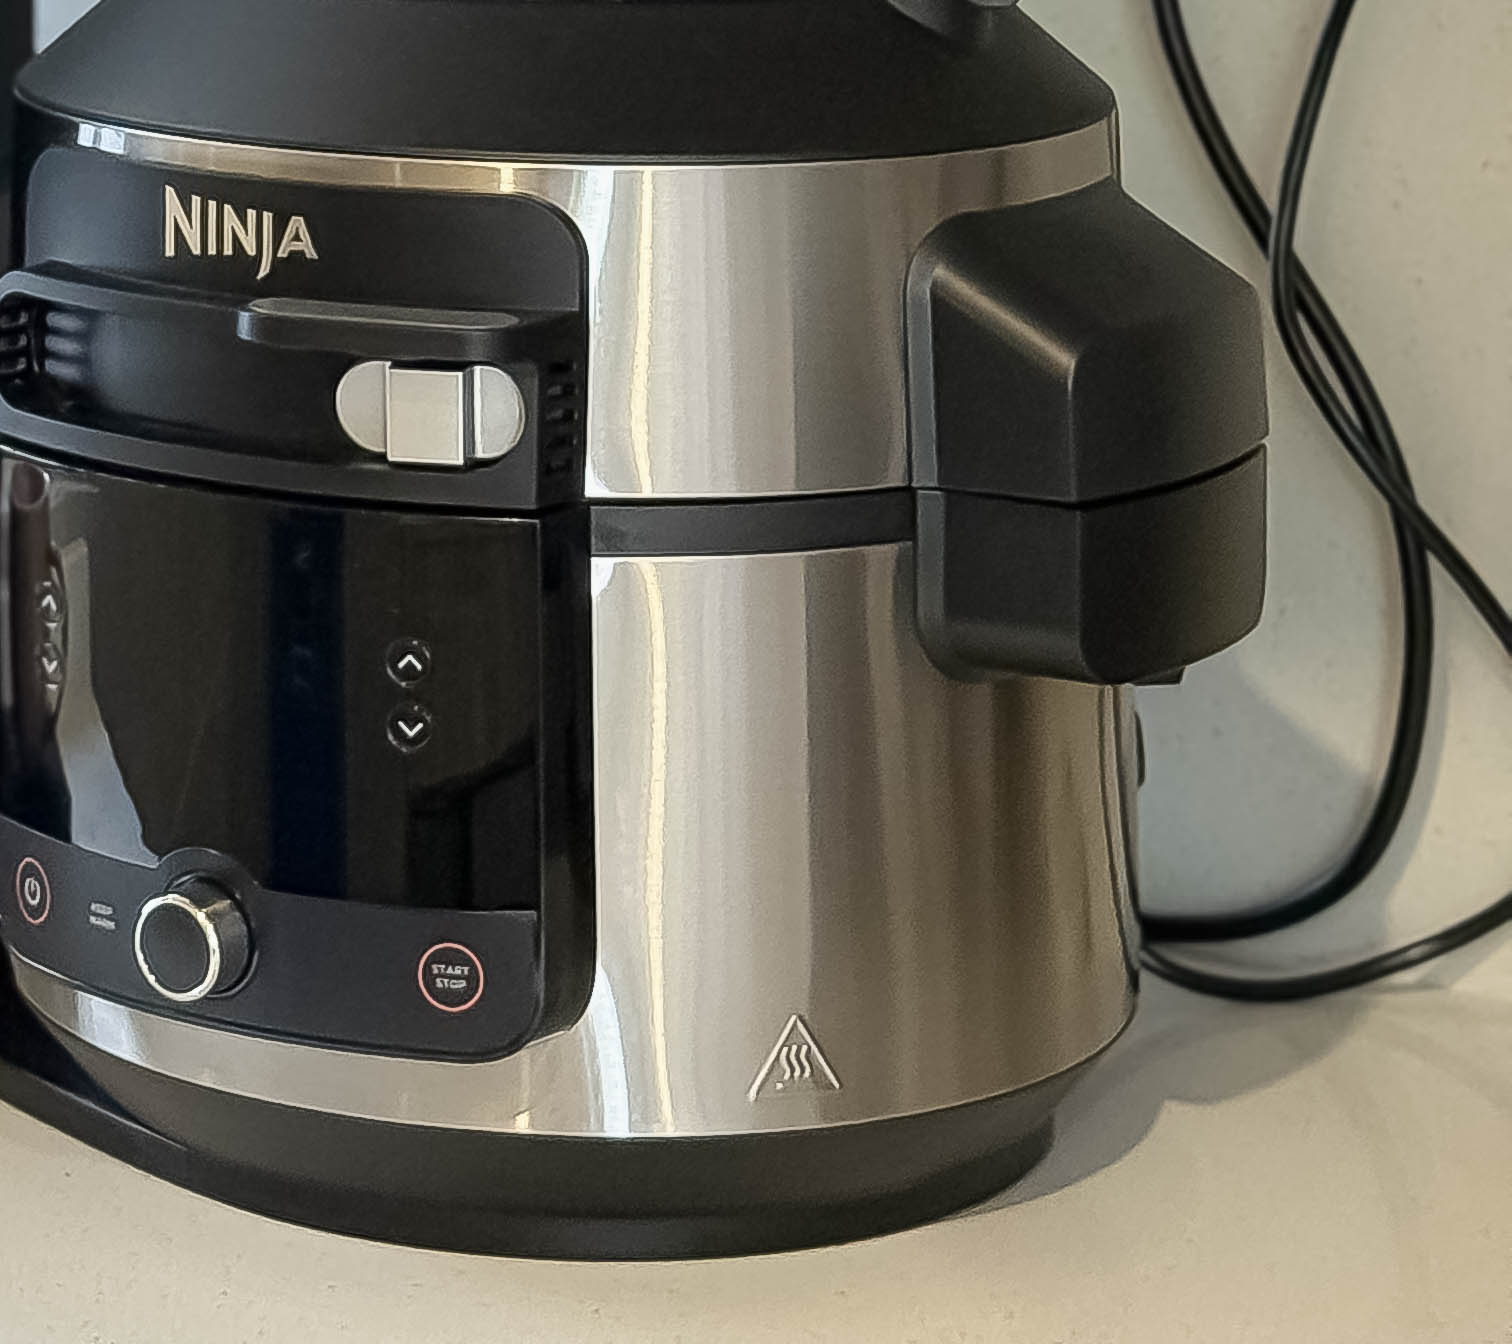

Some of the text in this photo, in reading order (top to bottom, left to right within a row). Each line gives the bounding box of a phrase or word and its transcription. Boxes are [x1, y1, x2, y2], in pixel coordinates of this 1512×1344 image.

[164, 184, 320, 281] NINJA
[431, 963, 471, 976] START
[435, 976, 468, 990] STOP
